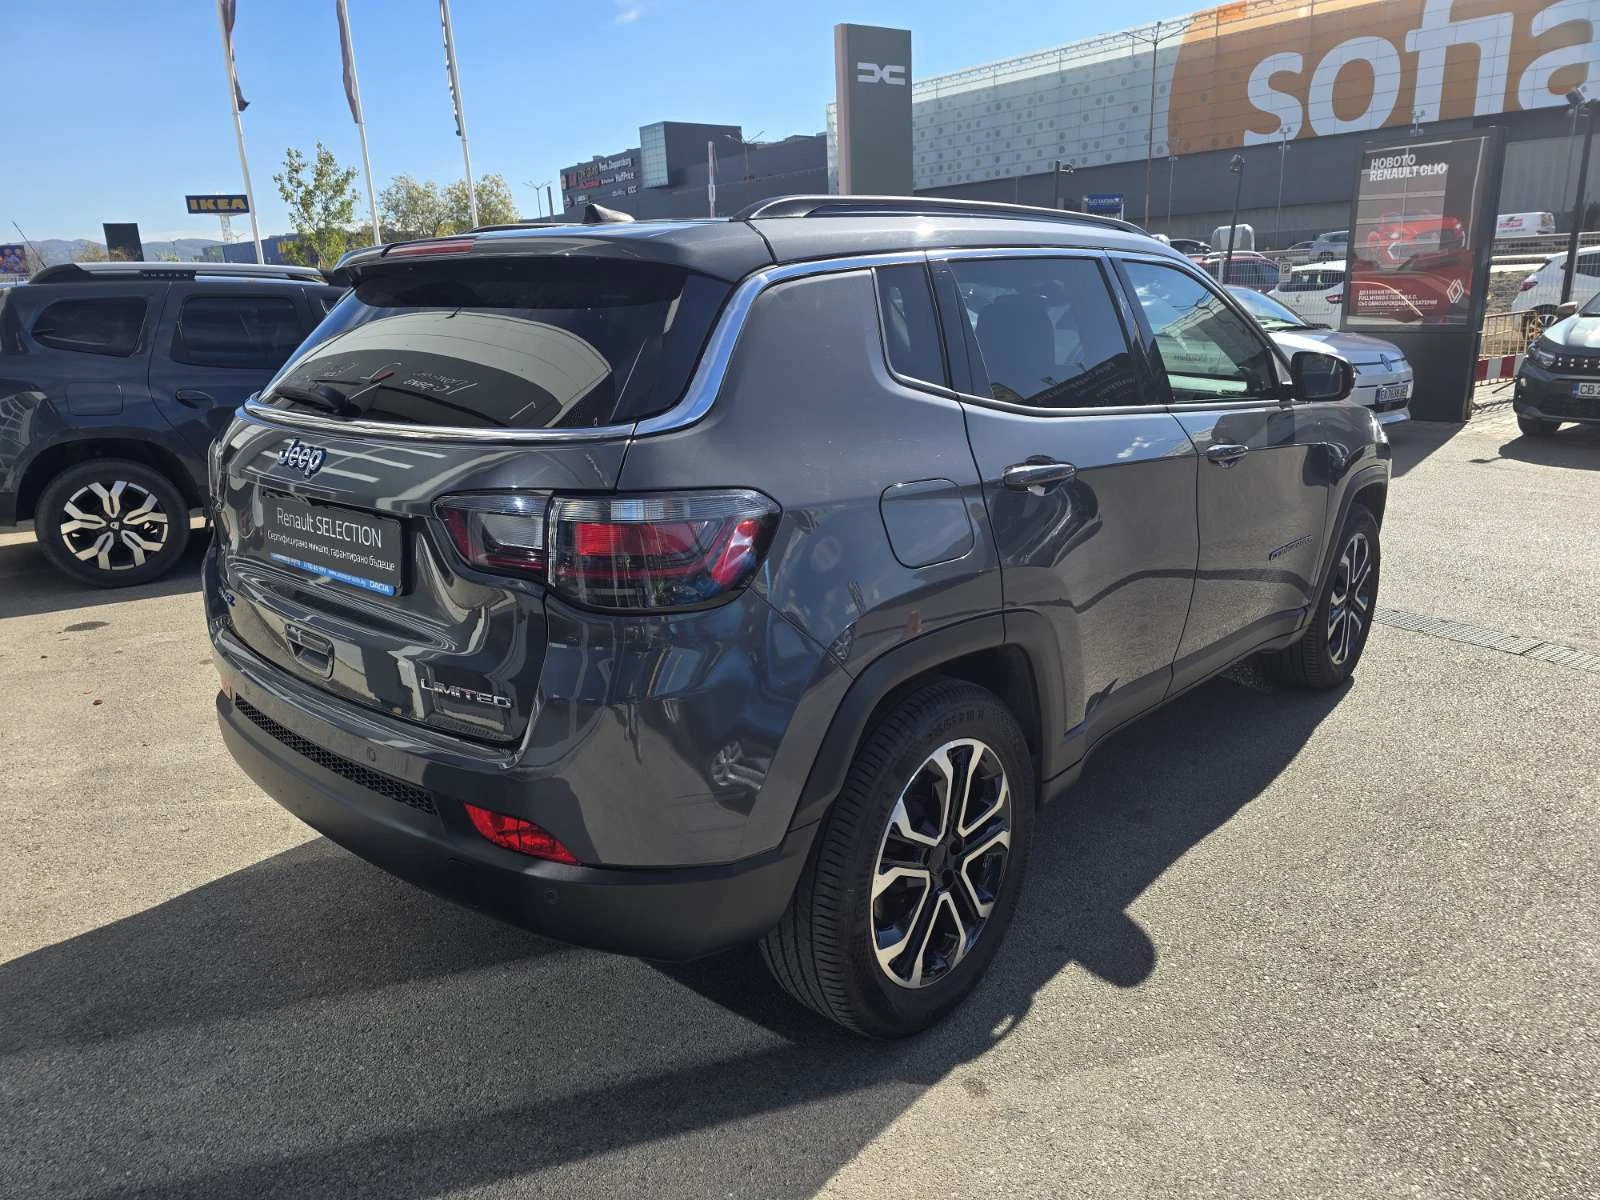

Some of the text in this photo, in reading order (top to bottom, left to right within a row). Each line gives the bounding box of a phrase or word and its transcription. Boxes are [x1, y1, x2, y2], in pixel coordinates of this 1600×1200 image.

[1243, 0, 1600, 147] sofia
[1369, 162, 1449, 182] RENAULT CLIO
[1371, 154, 1416, 170] НОВОТО
[189, 198, 247, 211] IKEA
[278, 438, 325, 477] Jeep
[276, 507, 382, 549] Renault SELECTION
[420, 678, 512, 708] LIMITED
